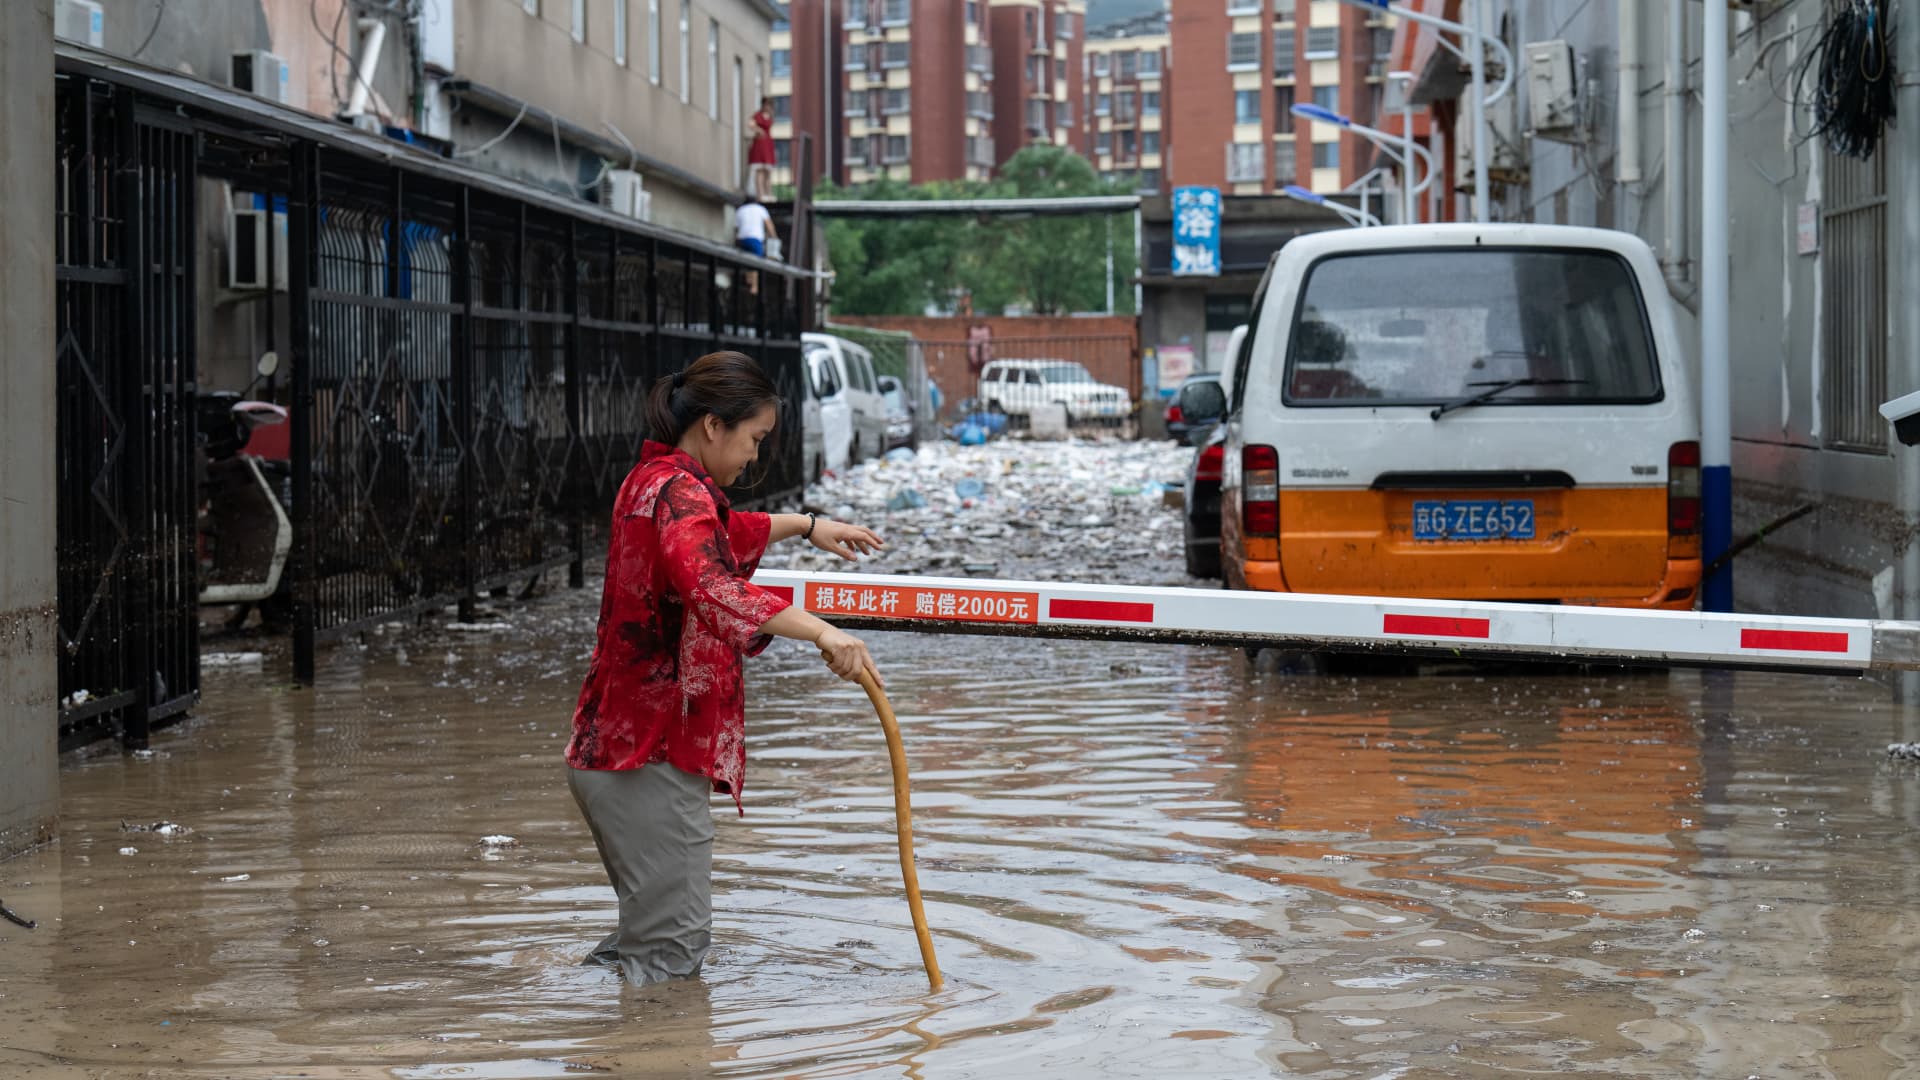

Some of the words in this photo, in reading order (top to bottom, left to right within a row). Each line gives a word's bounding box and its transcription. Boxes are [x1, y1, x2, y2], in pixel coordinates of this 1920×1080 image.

[815, 586, 900, 613] 损坏此杆
[915, 592, 1030, 620] 赔偿2000元
